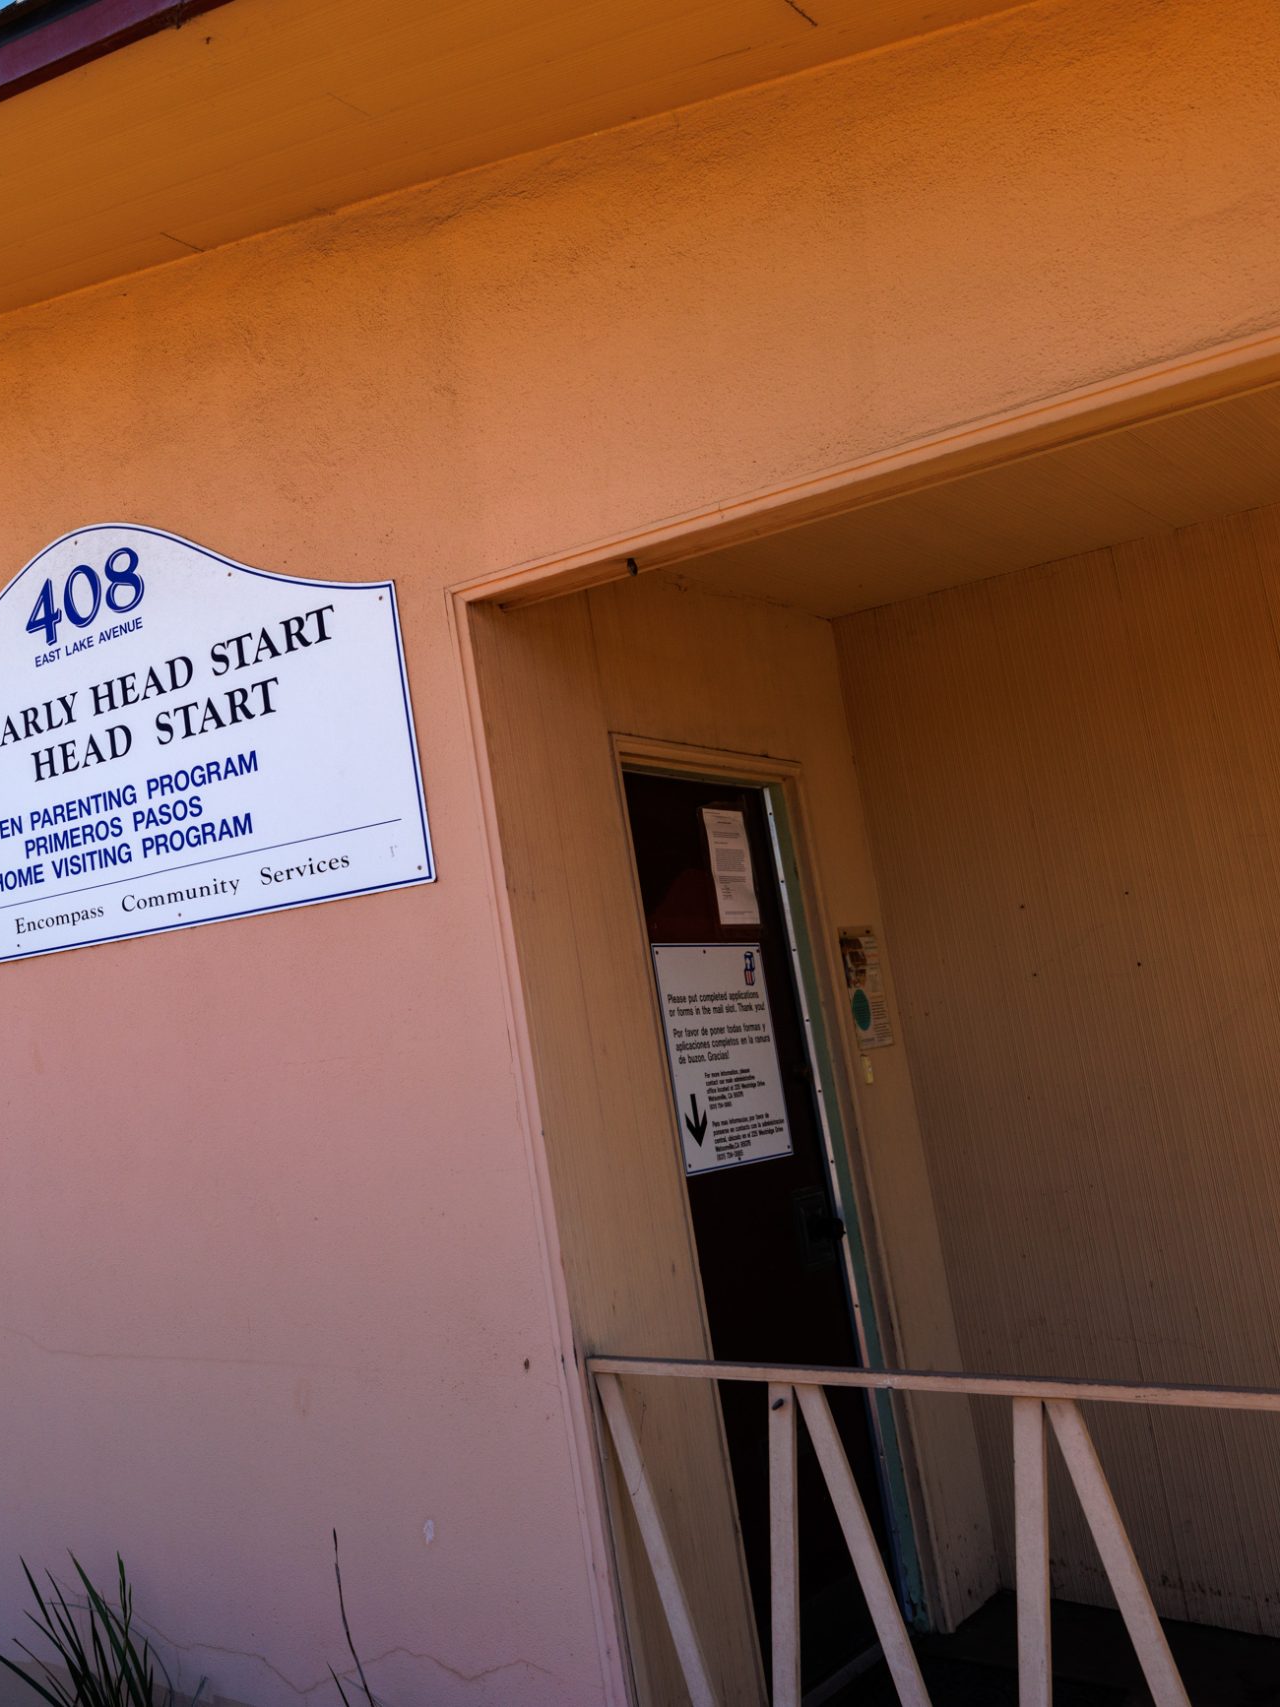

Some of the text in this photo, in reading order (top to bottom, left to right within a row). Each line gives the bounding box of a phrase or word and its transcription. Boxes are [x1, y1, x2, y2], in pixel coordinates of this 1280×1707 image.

[26, 547, 144, 648] 408
[35, 617, 143, 667] EAST LAKE AVENUE
[89, 656, 193, 716] HEAD
[211, 604, 334, 676] START
[31, 677, 278, 782] HEAD START
[30, 785, 137, 831] PARENTING
[147, 750, 258, 799] PROGRAM
[25, 796, 202, 859] PRIMEROS PASOS
[51, 843, 132, 879] VISITING
[142, 813, 253, 858] PROGRAM
[15, 908, 104, 934] Encompass
[122, 878, 239, 913] Community
[261, 856, 349, 885] Services
[667, 990, 759, 1004] Please put completed applications
[669, 1009, 675, 1017] or
[677, 1007, 694, 1016] forms
[695, 1006, 700, 1015] in
[702, 1006, 711, 1015] the
[713, 1004, 724, 1014] mail
[737, 1003, 753, 1012] Thank
[673, 1024, 765, 1038] Por favor de poner todas formas y
[676, 1041, 710, 1052] aplicaciones
[741, 1037, 747, 1045] en
[748, 1035, 754, 1044] la
[678, 1055, 686, 1064] de
